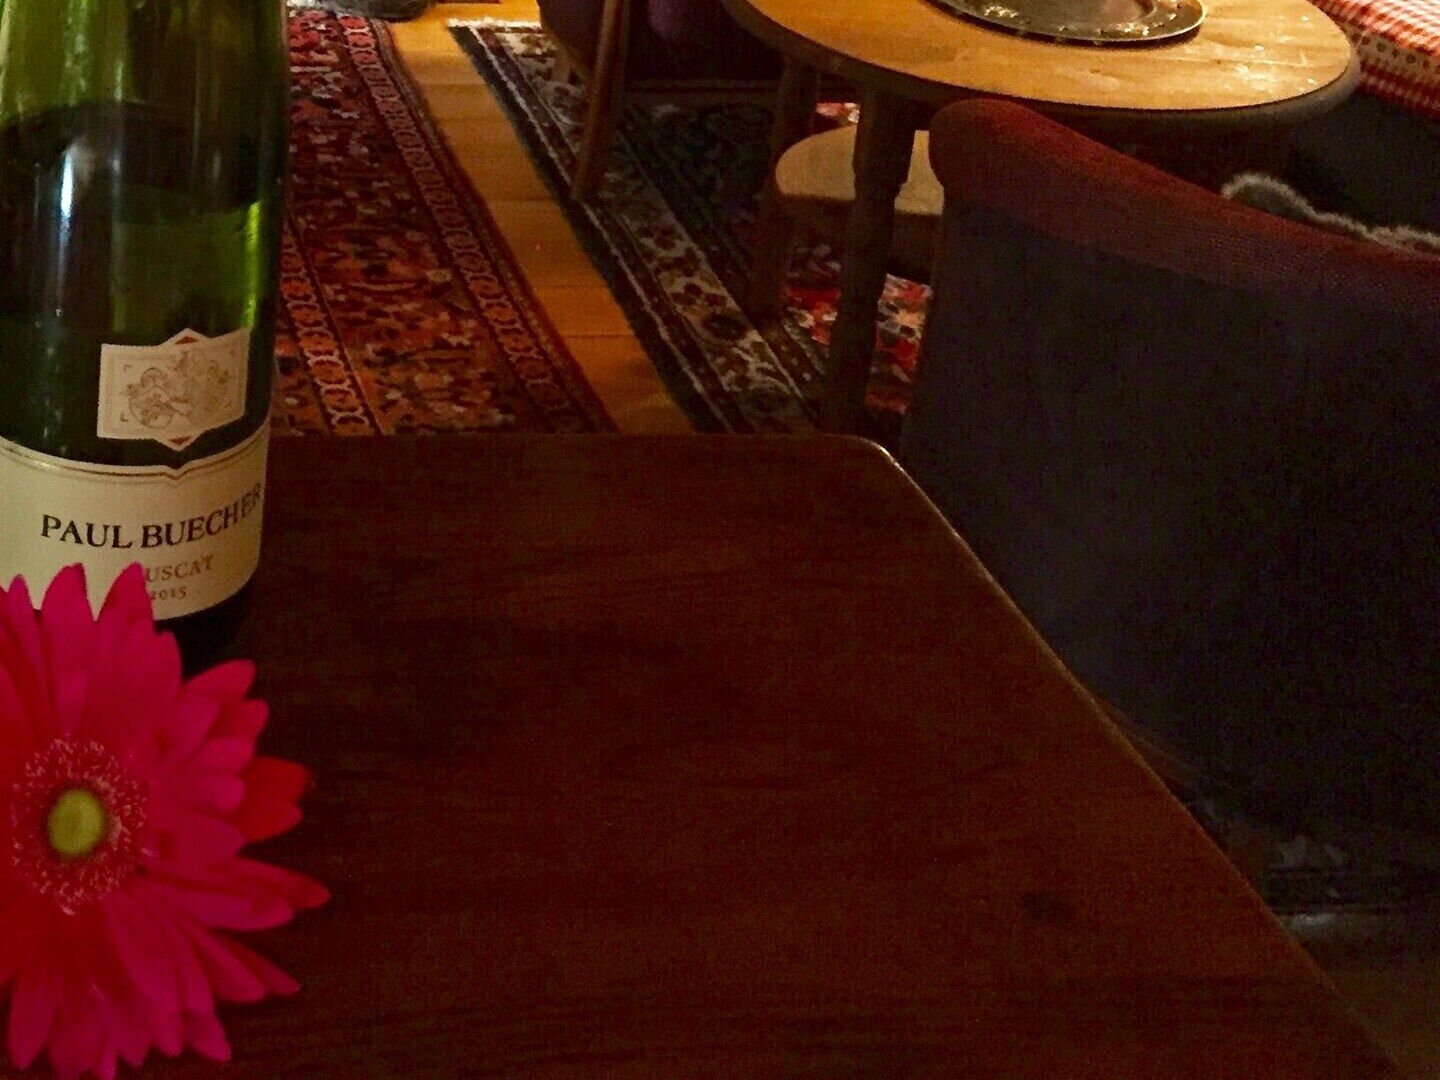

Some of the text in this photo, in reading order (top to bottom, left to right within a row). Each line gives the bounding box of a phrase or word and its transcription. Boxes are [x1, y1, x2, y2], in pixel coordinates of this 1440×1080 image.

[40, 514, 134, 549] PAUL
[145, 554, 214, 583] USCAT
[149, 586, 188, 601] 2015
